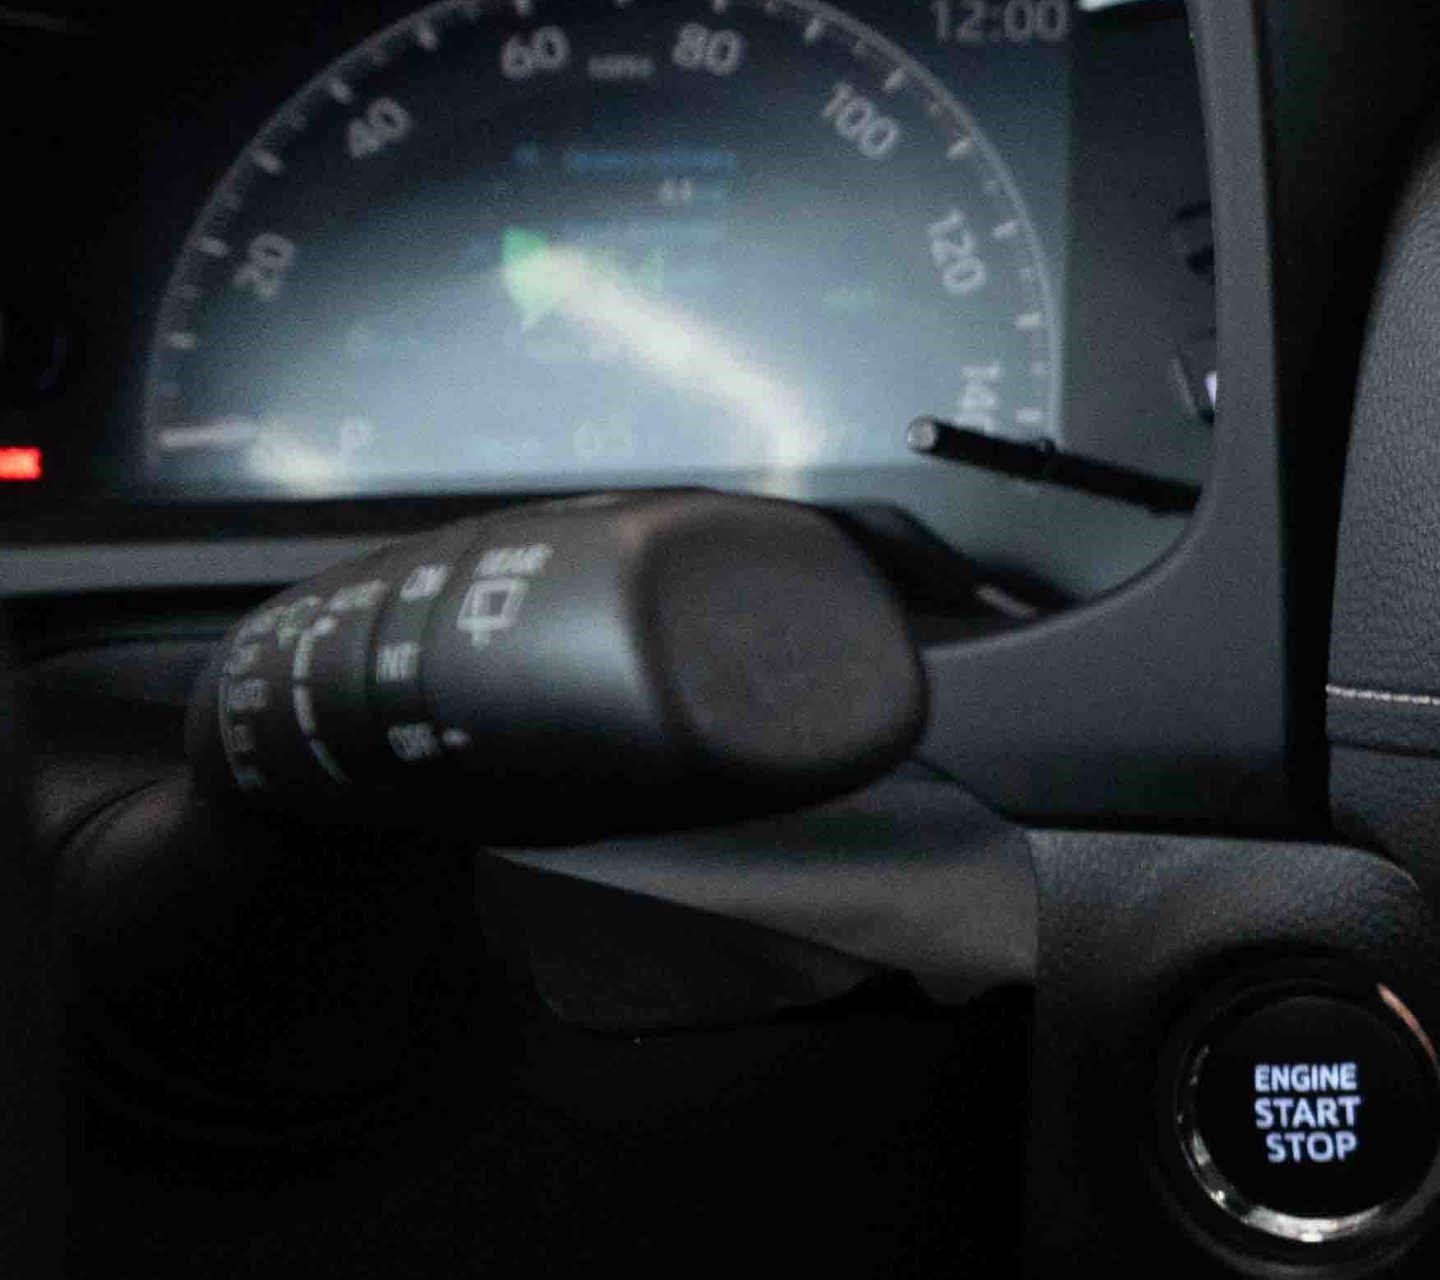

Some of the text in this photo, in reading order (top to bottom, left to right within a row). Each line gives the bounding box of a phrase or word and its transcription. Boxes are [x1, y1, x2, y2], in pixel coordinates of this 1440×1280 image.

[501, 24, 569, 80] 60
[671, 22, 742, 75] 80
[347, 97, 408, 157] 40
[821, 82, 898, 158] 100
[235, 233, 294, 300] 20
[928, 209, 986, 293] 120
[1254, 1063, 1357, 1092] ENGINE
[1254, 1095, 1361, 1129] START
[1266, 1130, 1357, 1163] STOP
